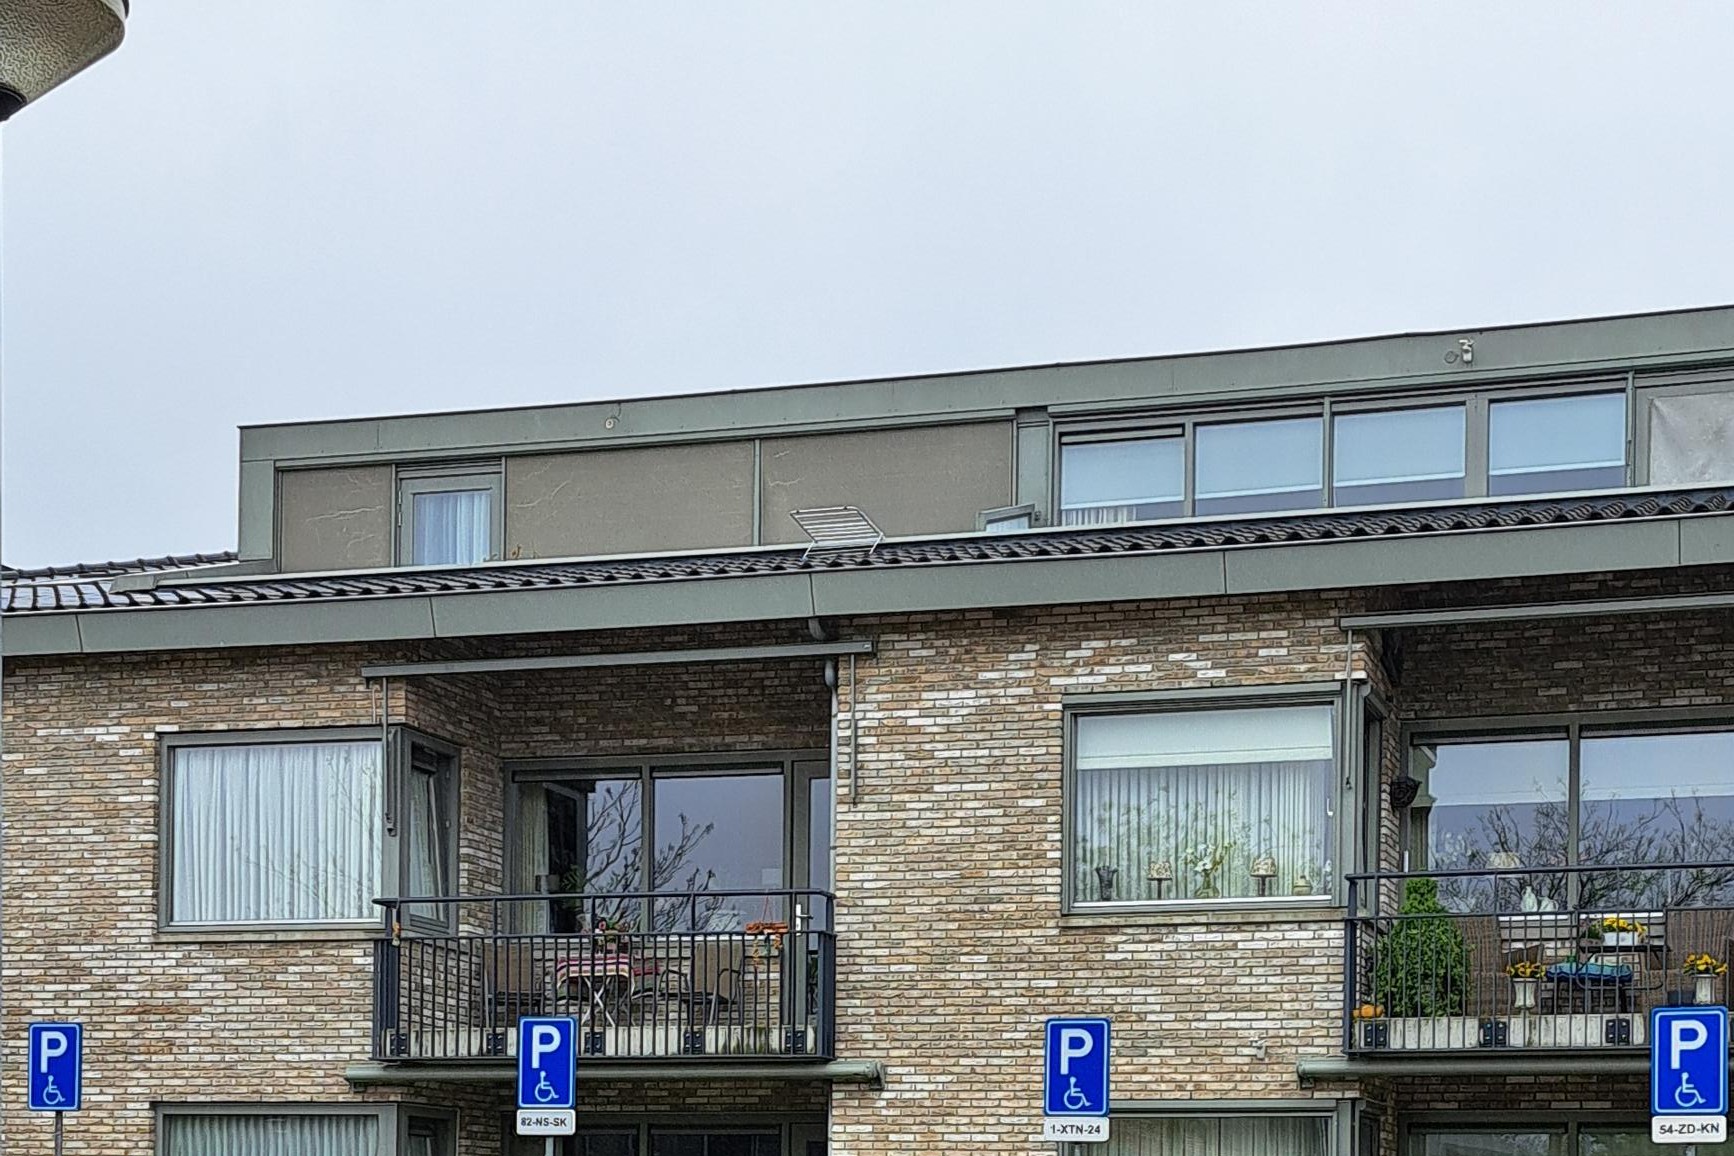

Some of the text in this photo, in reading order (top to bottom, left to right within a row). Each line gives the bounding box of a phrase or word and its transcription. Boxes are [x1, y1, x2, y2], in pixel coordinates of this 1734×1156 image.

[40, 1030, 68, 1074] P
[531, 1024, 562, 1069] P
[1060, 1028, 1094, 1075] P
[1670, 1019, 1708, 1070] P
[520, 1117, 567, 1127] 82-NS-SK
[1051, 1124, 1101, 1135] 1-XTN-24
[1658, 1122, 1720, 1134] 54-ZD-KN
